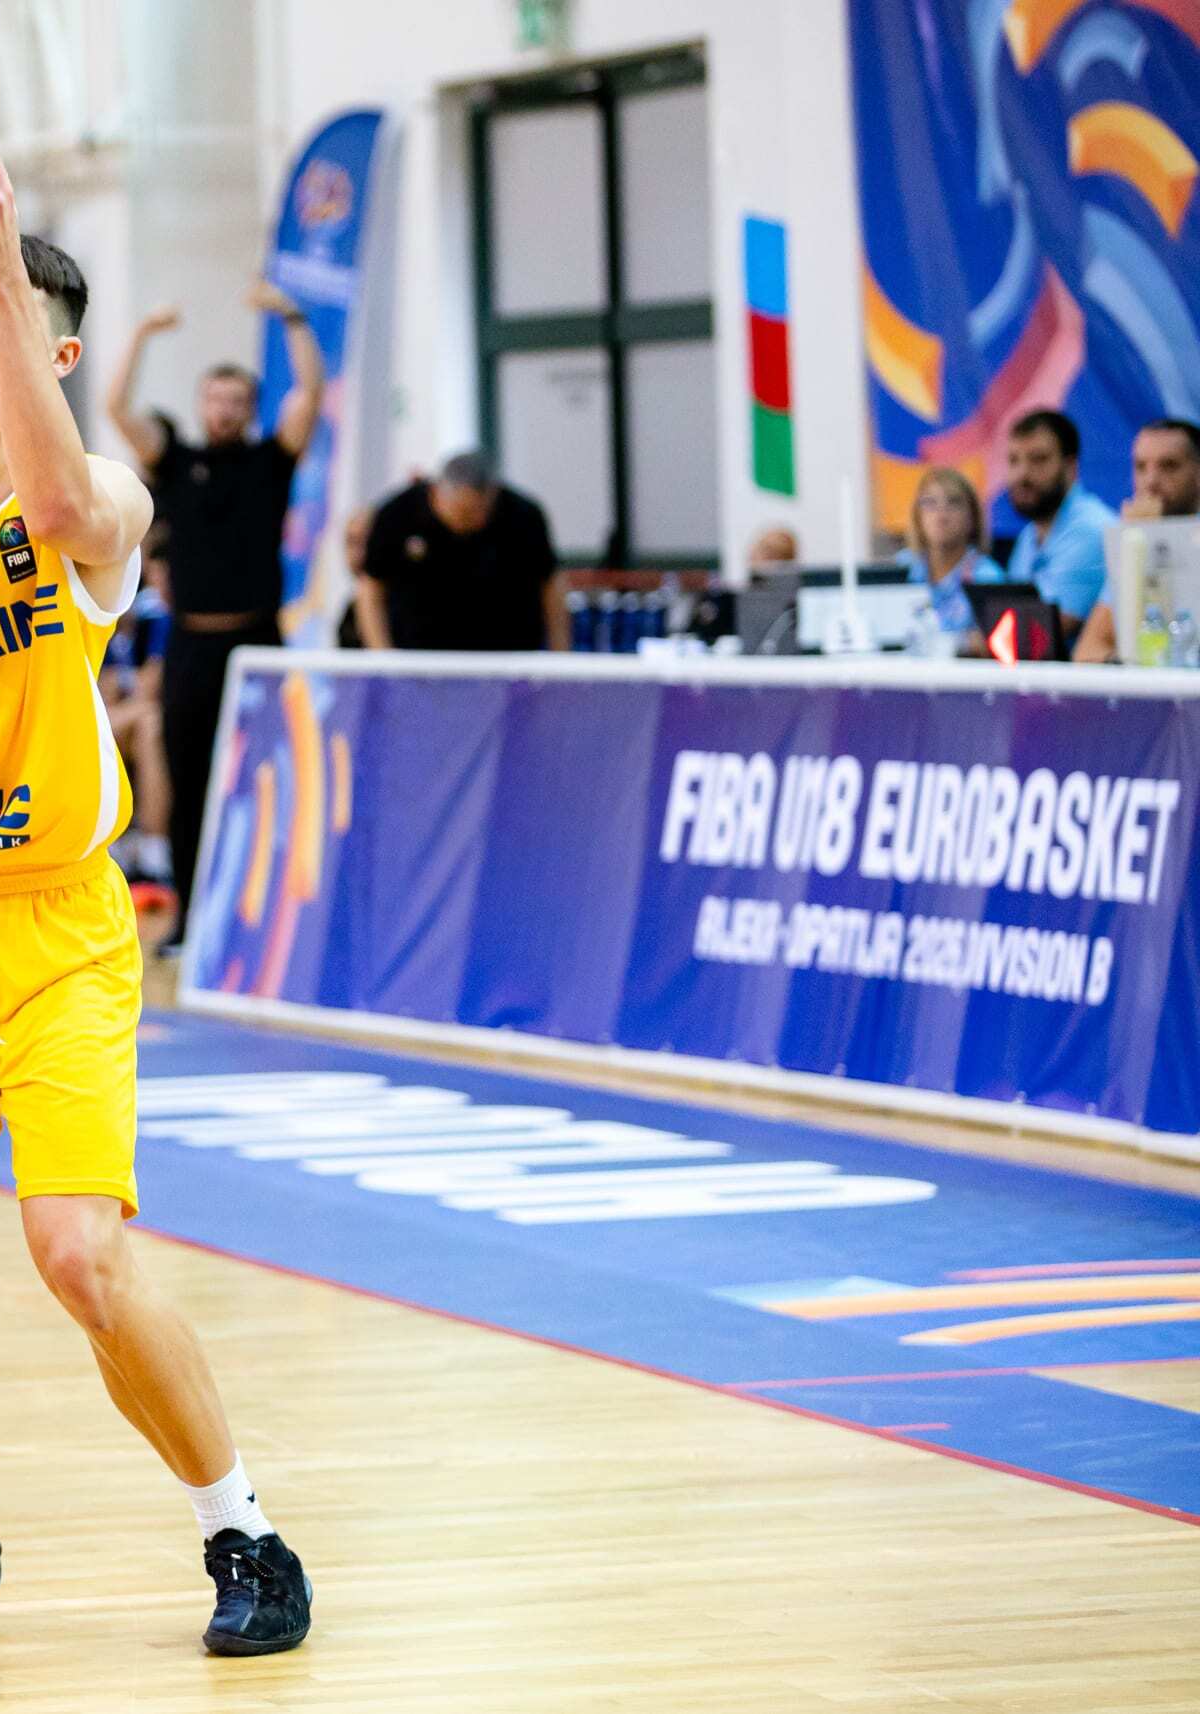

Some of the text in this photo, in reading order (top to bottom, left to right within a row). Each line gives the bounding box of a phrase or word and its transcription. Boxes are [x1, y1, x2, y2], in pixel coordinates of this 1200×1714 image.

[7, 550, 30, 567] FIBA
[659, 750, 1181, 905] FIBA U18 EUROBASKET
[1085, 937, 1114, 1006] B
